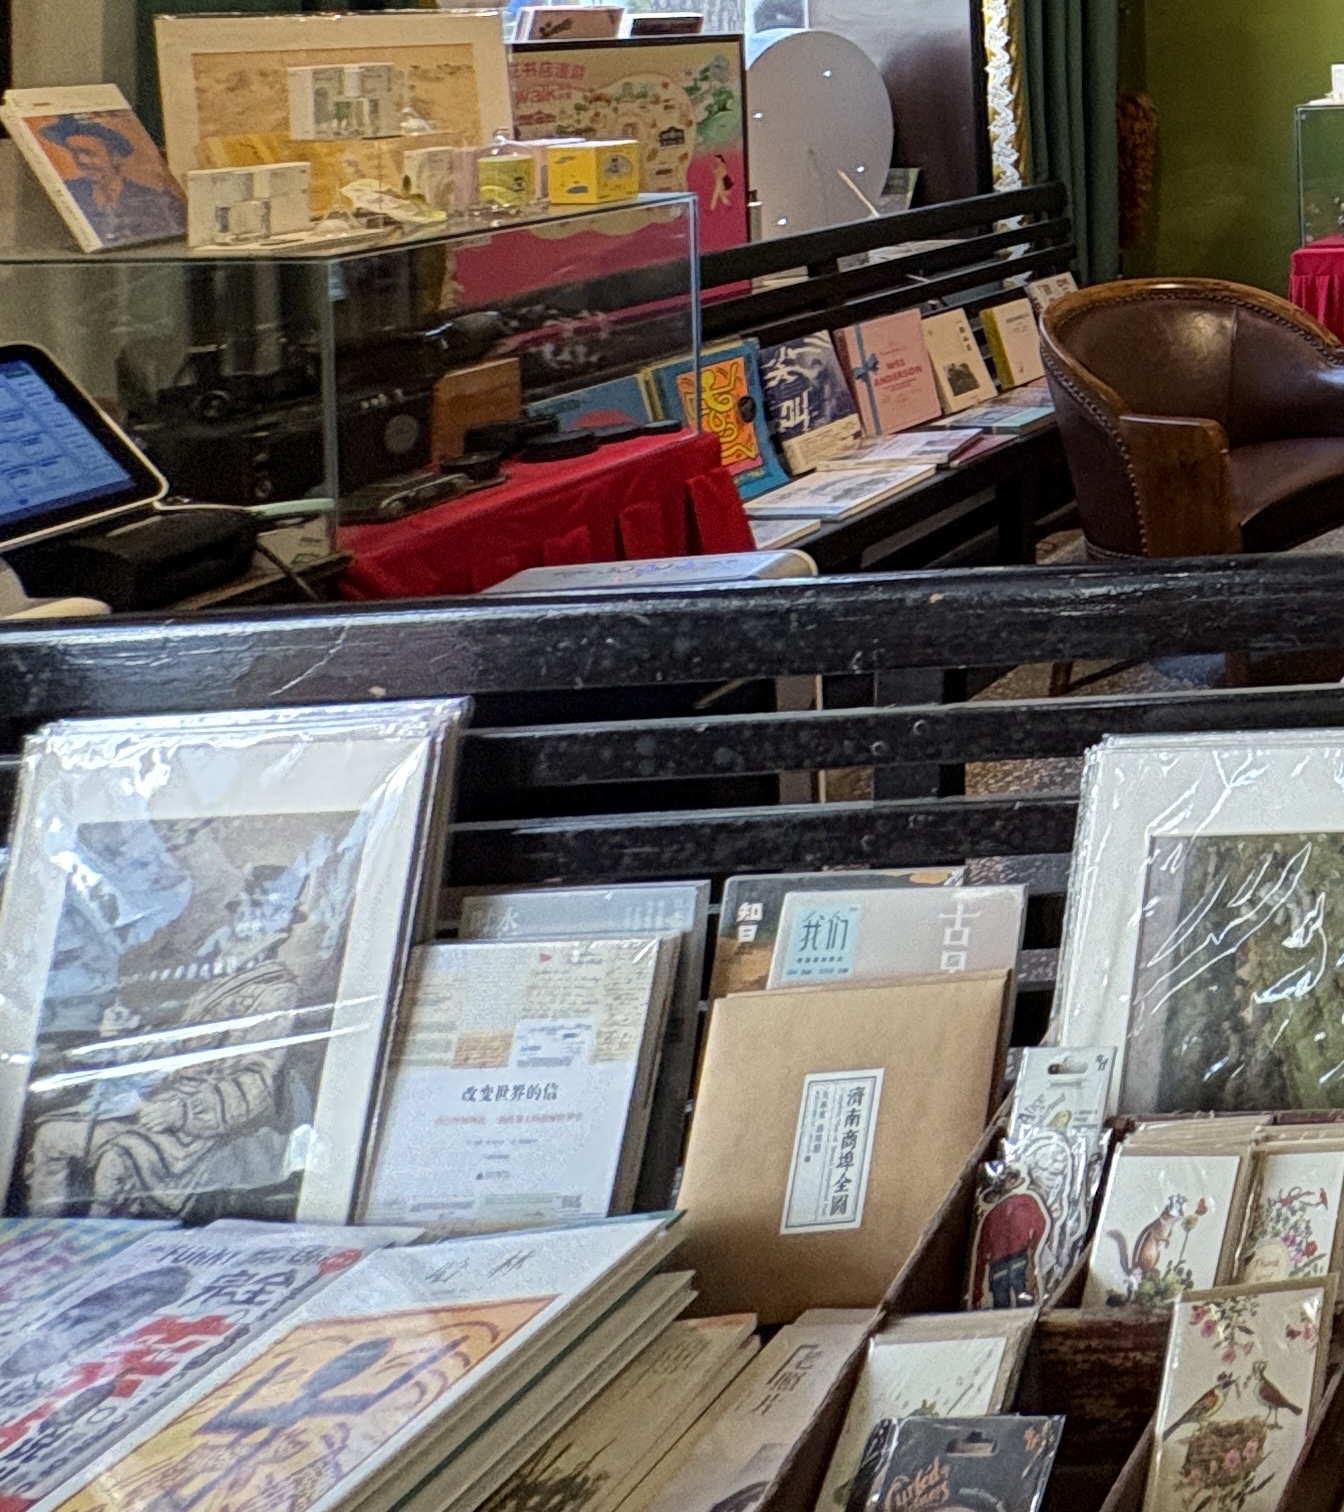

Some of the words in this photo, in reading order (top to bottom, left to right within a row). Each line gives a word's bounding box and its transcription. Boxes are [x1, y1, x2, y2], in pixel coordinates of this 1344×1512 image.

[736, 901, 763, 942] 知日
[800, 910, 849, 951] 我们
[461, 1082, 559, 1102] 改变世界的信
